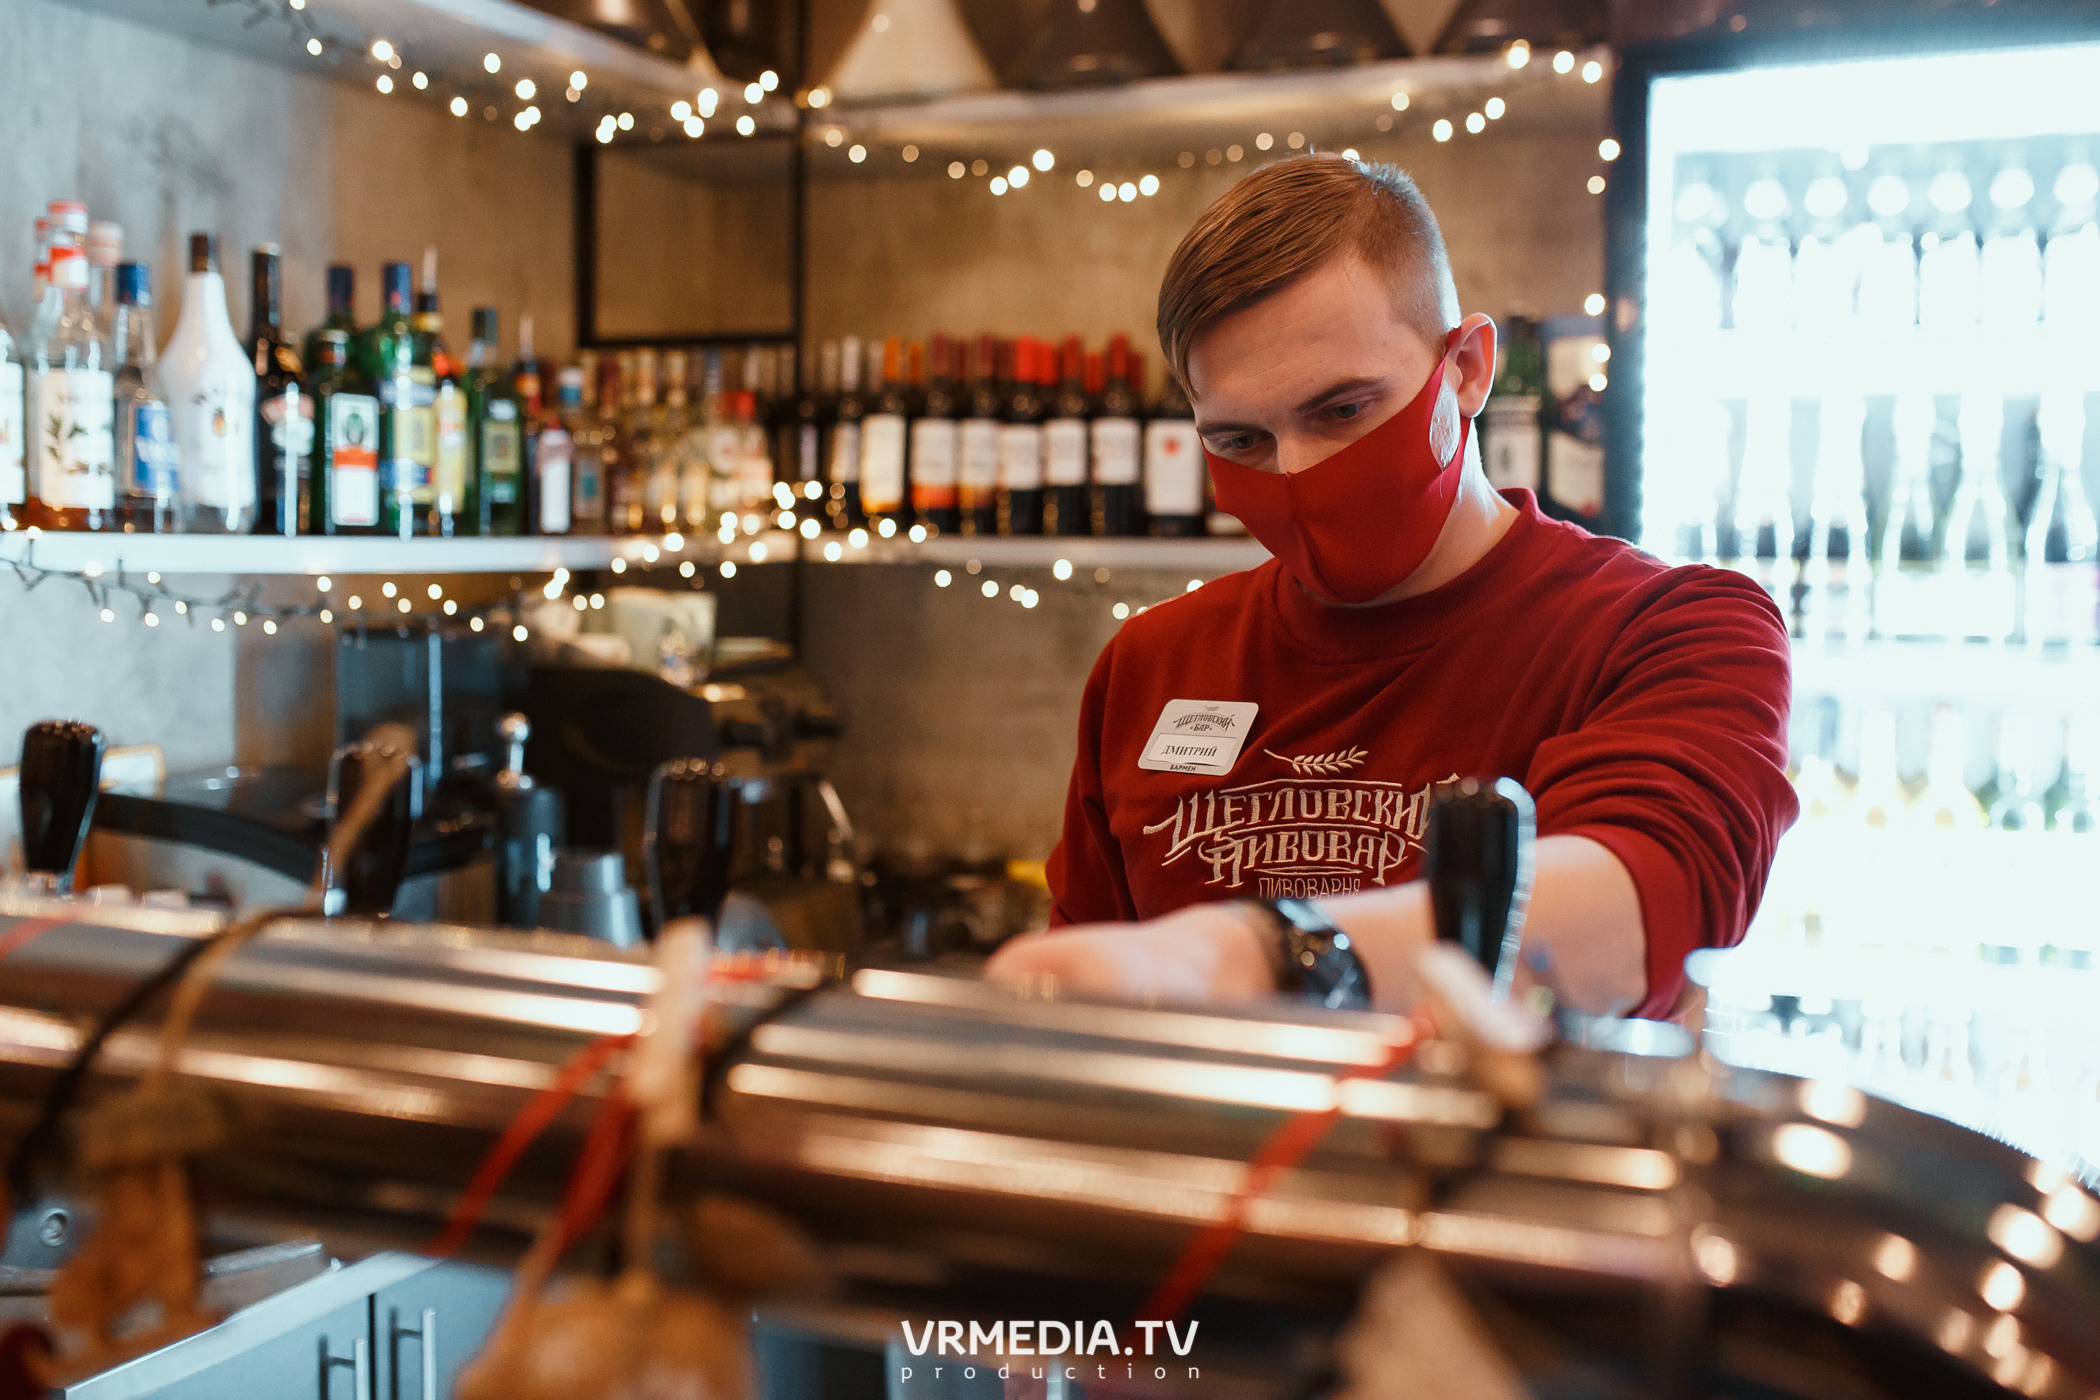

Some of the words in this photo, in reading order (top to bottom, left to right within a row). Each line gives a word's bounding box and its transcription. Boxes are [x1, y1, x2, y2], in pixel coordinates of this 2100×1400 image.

[1173, 713, 1235, 731] ЩЕГЛОВСКИЙ
[1193, 723, 1211, 732] БАР
[1160, 744, 1218, 757] ДМИТРИЙ
[1169, 763, 1197, 772] БАРМЕН
[1198, 831, 1408, 888] ПИВОВАР
[1258, 876, 1361, 899] ПИВОВАРНЯ
